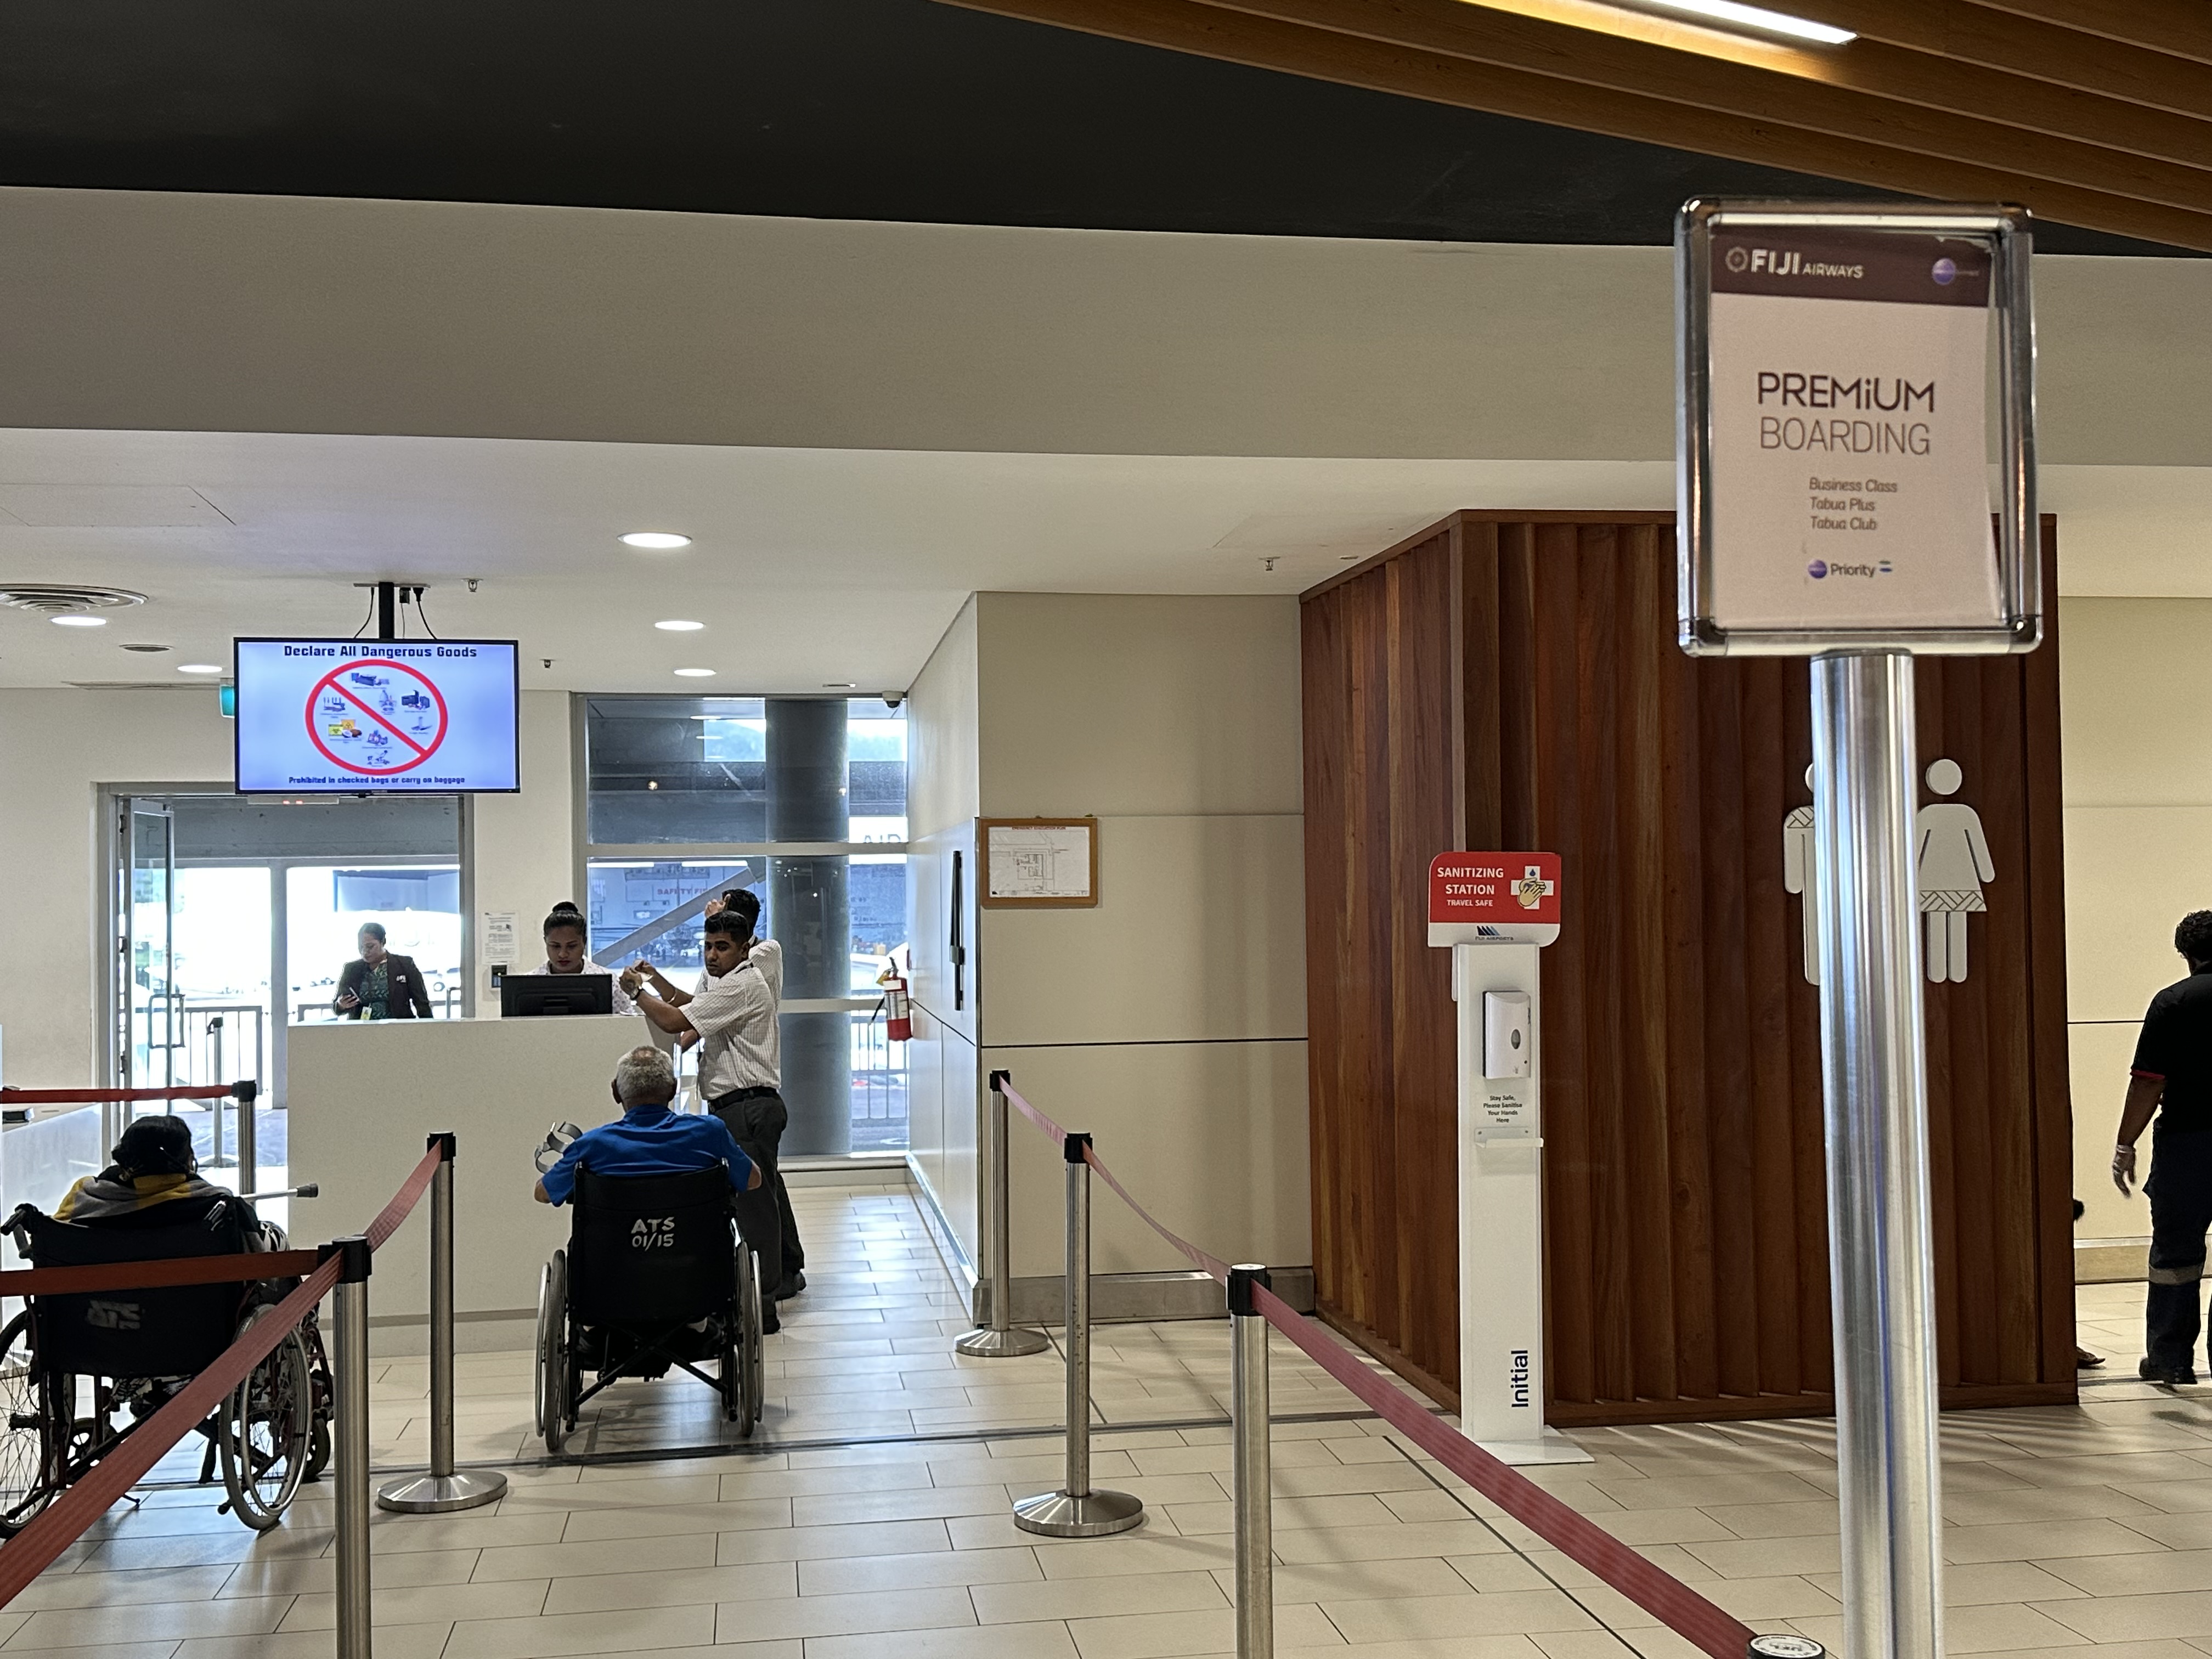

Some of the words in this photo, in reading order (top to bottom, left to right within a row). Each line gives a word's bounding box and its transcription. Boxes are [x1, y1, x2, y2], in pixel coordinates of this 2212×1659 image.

[1751, 249, 1801, 275] FIJI
[1802, 262, 1864, 279] AIRWAYS
[1760, 416, 1930, 455] BOARDING
[1809, 477, 1862, 492] Business
[1865, 479, 1898, 493] Class
[1810, 496, 1846, 511] Tabua
[1849, 498, 1875, 511] Plus
[1810, 516, 1847, 529] Tabua
[1850, 517, 1877, 531] Club
[1830, 563, 1875, 578] Priority
[284, 646, 335, 656] Declare
[340, 646, 356, 656] All
[362, 646, 432, 659] Dangerous
[437, 646, 477, 657] Goods
[435, 776, 465, 785] baggage
[1437, 867, 1504, 878] SANITIZING
[1445, 884, 1495, 895] STATION
[630, 1216, 675, 1234] ATS
[631, 1232, 675, 1252] 01/15
[1510, 1350, 1528, 1408] Initial
